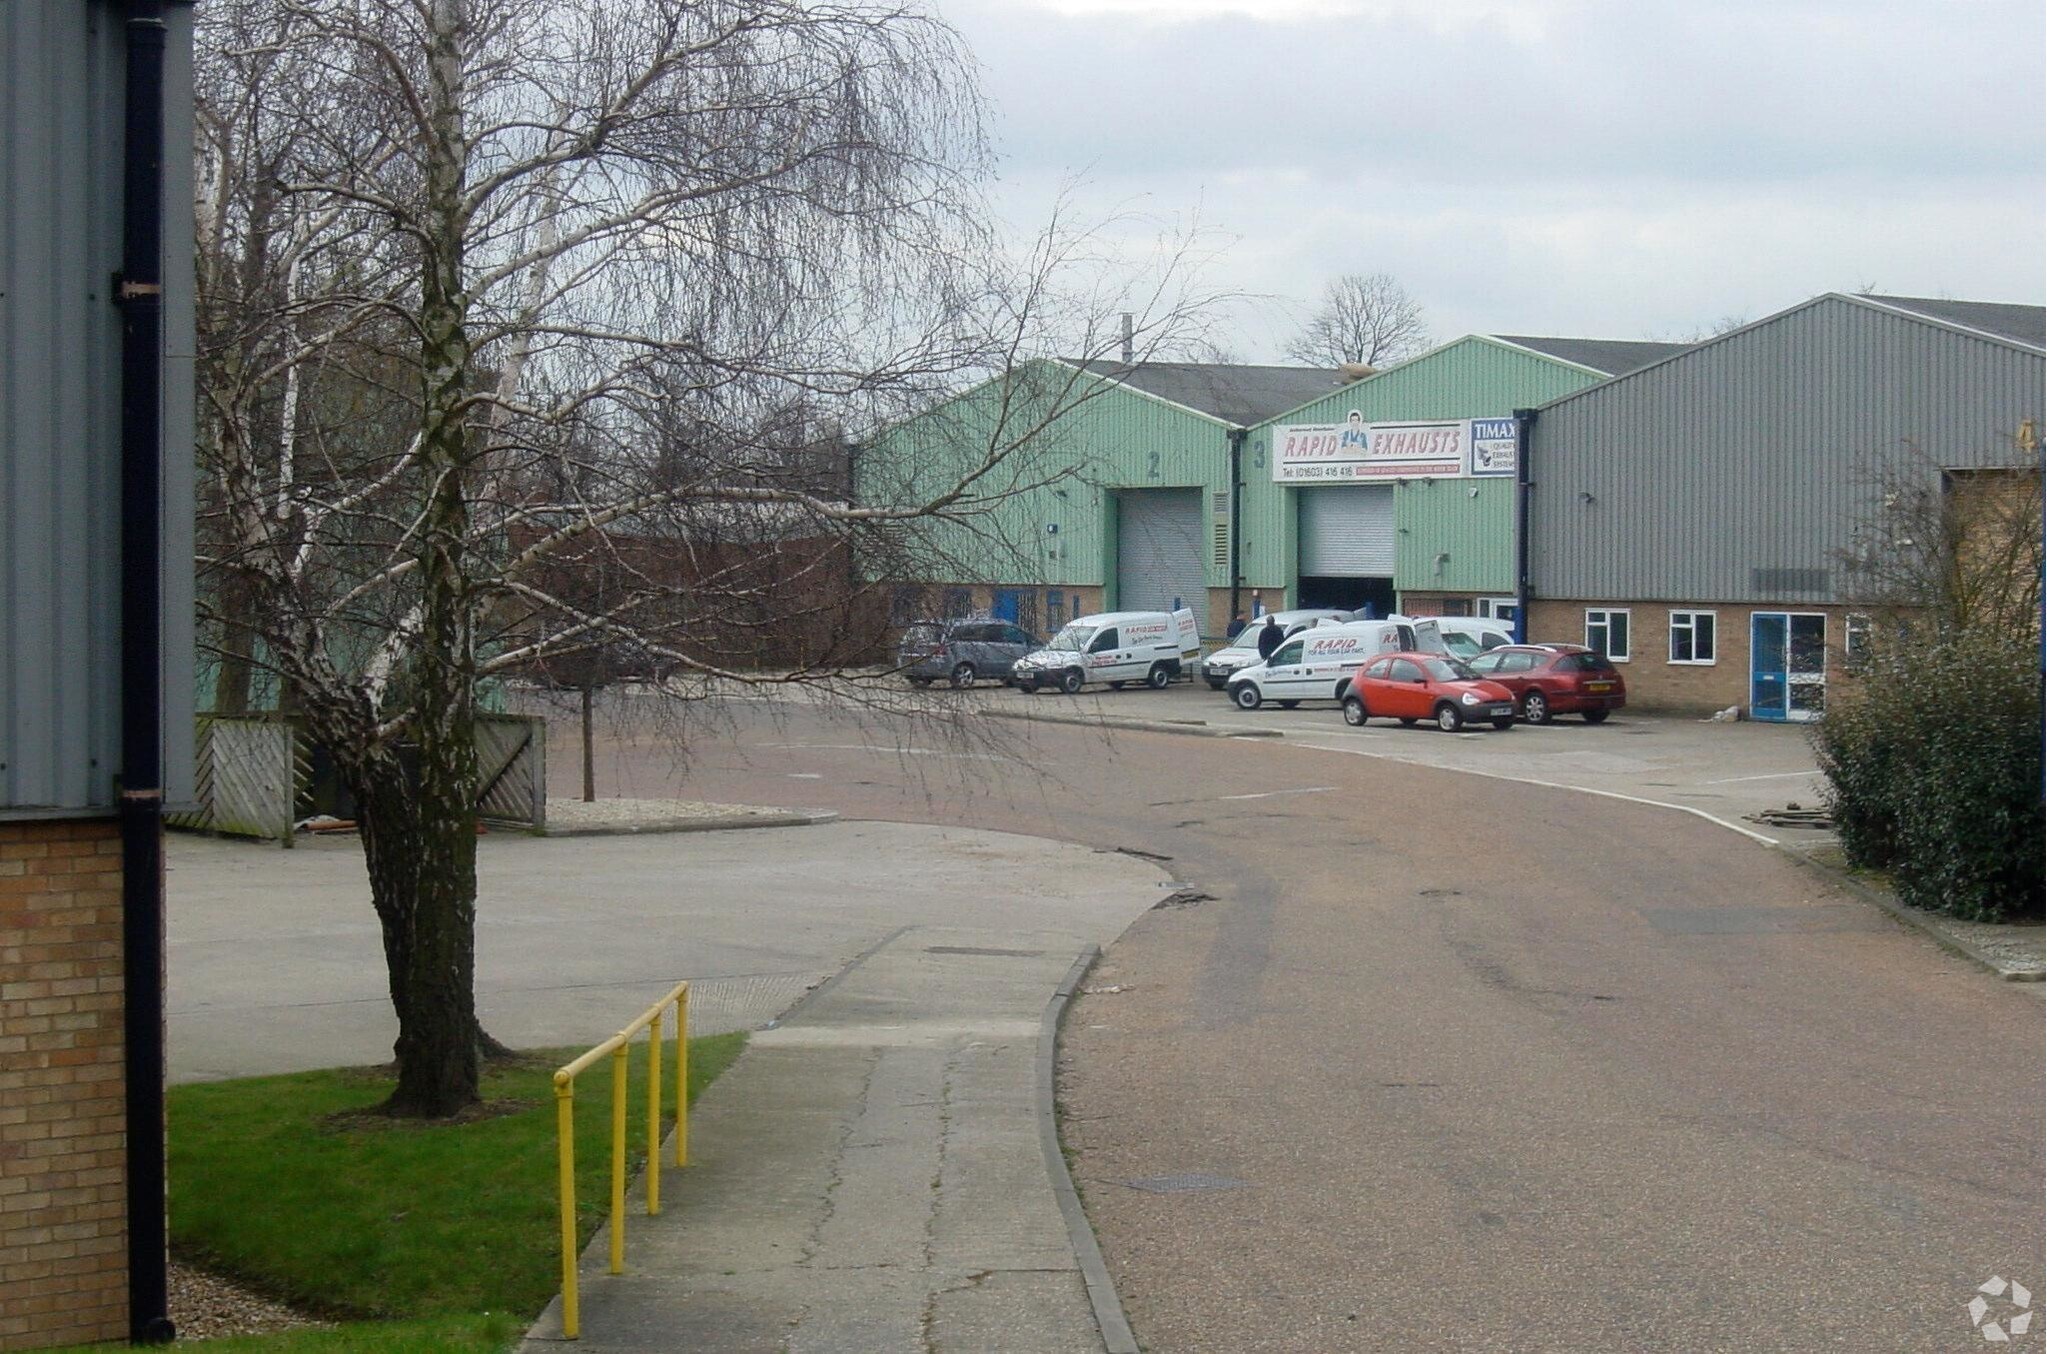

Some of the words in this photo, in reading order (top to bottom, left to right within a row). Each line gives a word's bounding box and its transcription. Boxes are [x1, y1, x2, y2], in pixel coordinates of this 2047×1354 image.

[1285, 435, 1338, 457] RAPID
[1372, 430, 1460, 454] EXHAUSTS
[1475, 422, 1515, 439] TIMAX
[1149, 451, 1160, 478] 2
[1254, 441, 1265, 468] 3
[1314, 639, 1357, 649] RAPID
